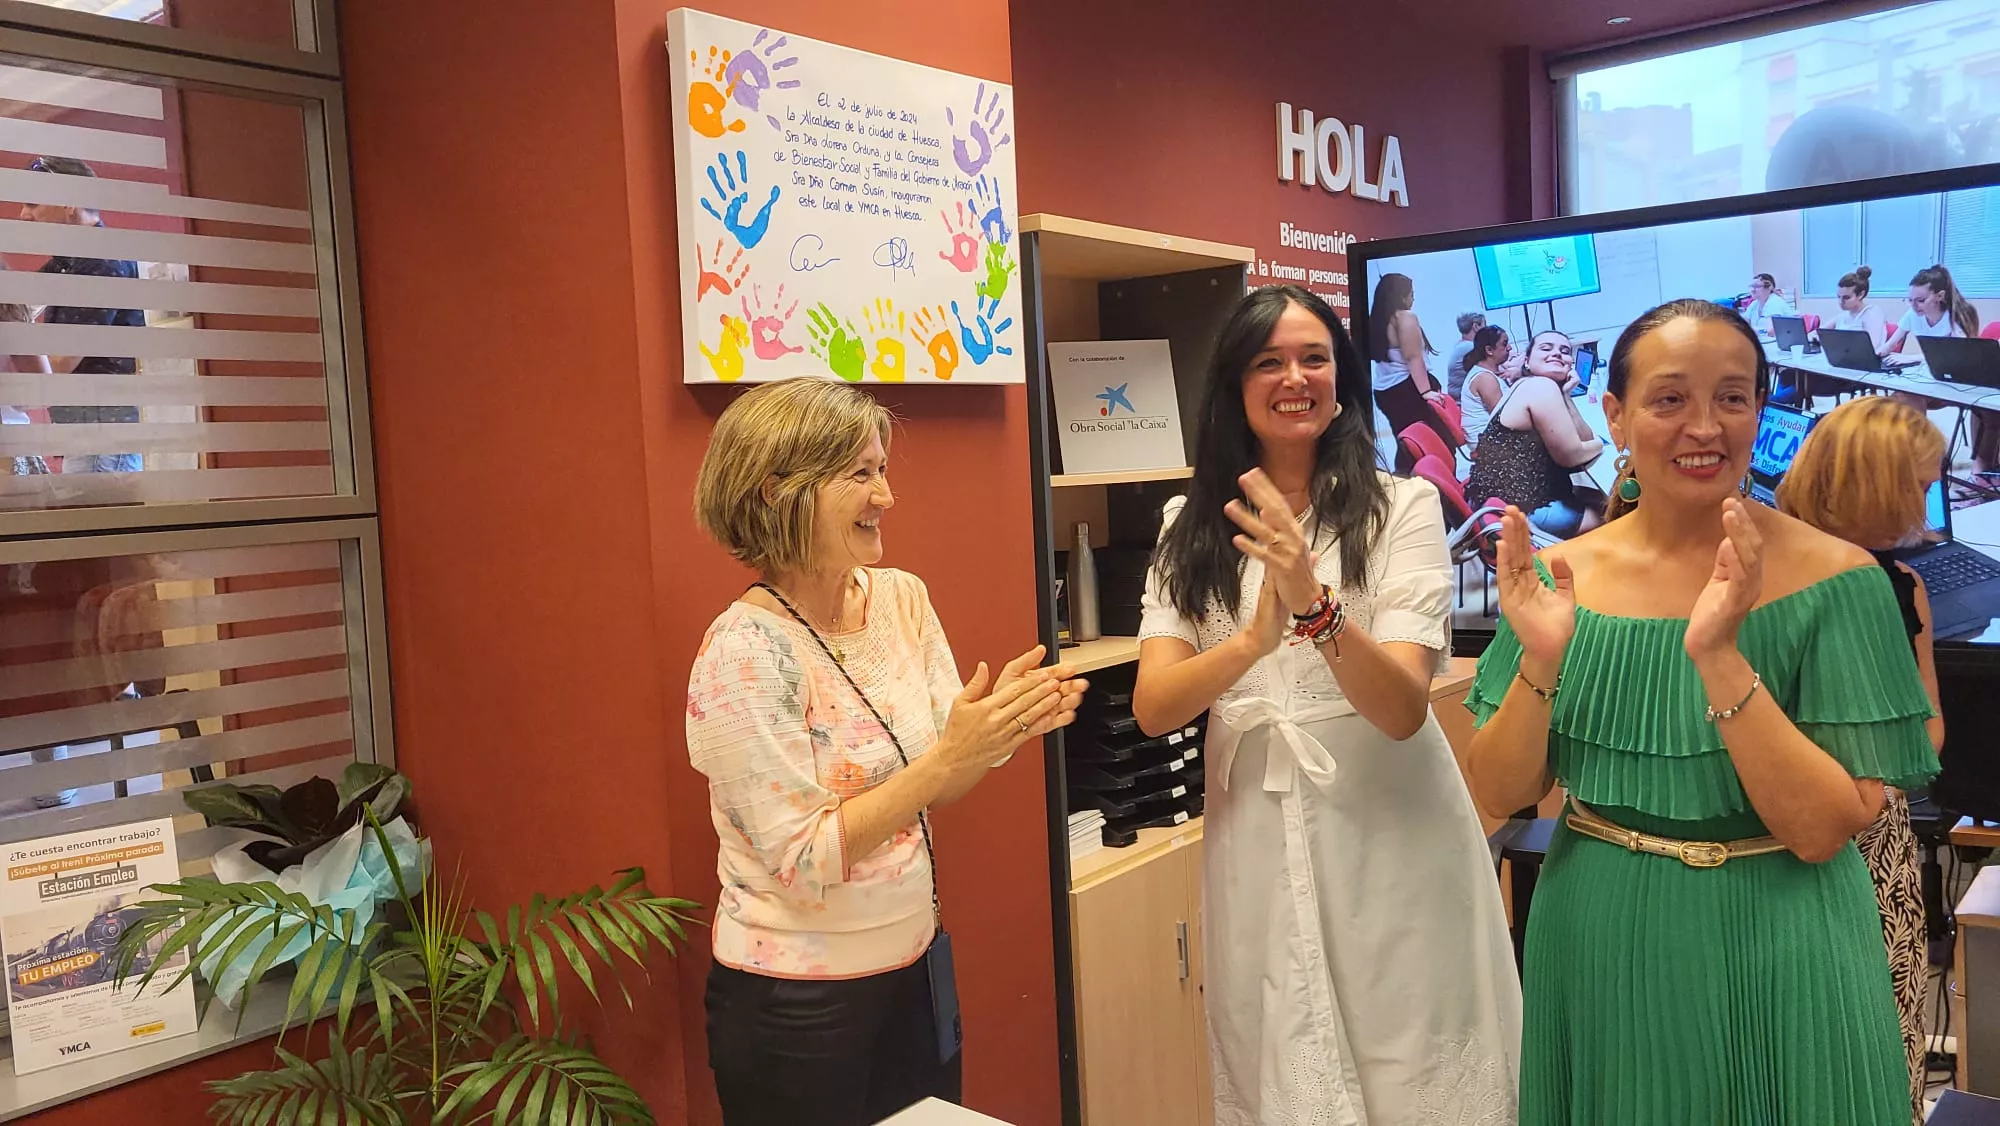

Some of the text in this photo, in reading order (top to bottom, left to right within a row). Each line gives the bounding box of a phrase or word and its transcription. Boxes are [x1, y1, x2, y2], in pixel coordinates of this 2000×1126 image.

[817, 92, 917, 125] El 2 de julio de 2024
[799, 109, 840, 130] Alcaldesa
[845, 119, 855, 132] de
[858, 120, 865, 135] la
[868, 124, 893, 139] ciudad
[898, 130, 907, 141] de
[912, 129, 942, 149] Huesca,
[785, 129, 800, 142] Sra
[884, 150, 891, 162] y
[894, 150, 903, 161] la
[907, 150, 939, 170] Consejera
[1276, 102, 1409, 207] HOLA
[773, 148, 787, 162] de
[791, 149, 838, 170] Bienestar
[839, 156, 861, 174] Social
[864, 166, 871, 180] y
[873, 162, 898, 180] Familia
[900, 168, 911, 184] del
[913, 170, 940, 188] Gobierno
[942, 175, 950, 188] de
[792, 170, 806, 186] Sra
[829, 176, 858, 194] Carmen
[891, 187, 932, 205] inauguraron
[798, 194, 817, 209] este
[844, 200, 854, 213] de
[857, 200, 880, 216] YMCA
[882, 208, 891, 218] en
[1259, 258, 1269, 277] la
[1271, 260, 1306, 281] forman
[1308, 269, 1349, 285] personas
[1070, 422, 1096, 433] Obra
[1097, 420, 1126, 432] Social
[1777, 416, 1806, 432] Ayudar
[9, 827, 161, 862] ¿Te cuesta encontrar trabajo?
[50, 862, 60, 870] al
[86, 851, 124, 864] Próxima
[125, 844, 163, 858] parada:
[41, 876, 91, 896] Estación
[94, 869, 135, 887] Empleo
[17, 946, 90, 971] Próxima estación:
[20, 954, 94, 985] TU EMPLEO
[59, 1041, 91, 1055] YMCA
